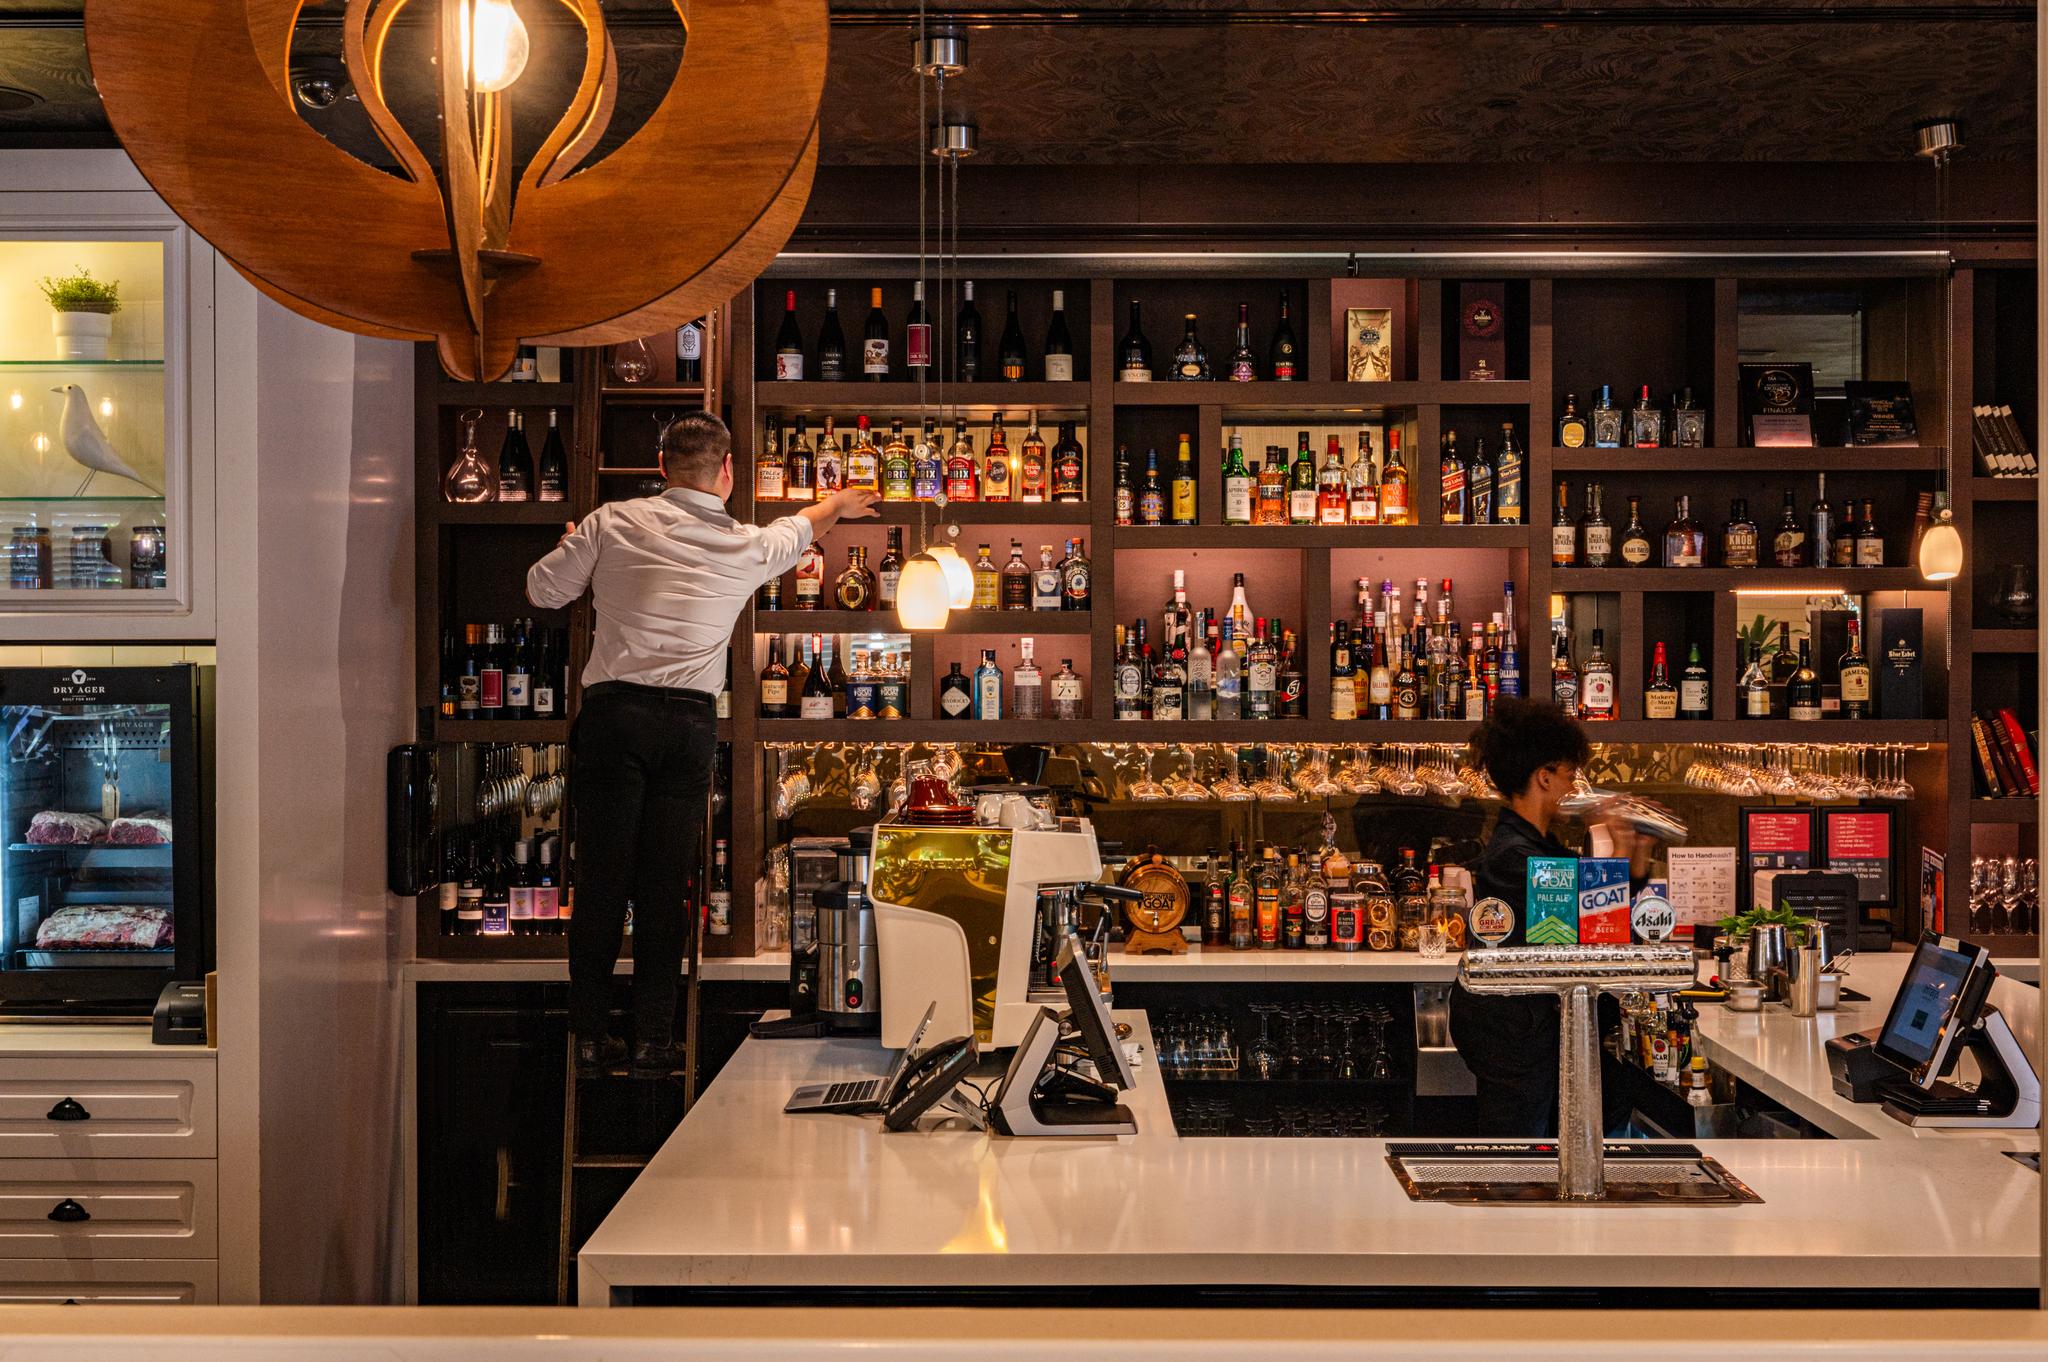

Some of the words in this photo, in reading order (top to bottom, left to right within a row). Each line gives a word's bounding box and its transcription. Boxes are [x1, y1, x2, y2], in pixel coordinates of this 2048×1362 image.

[887, 470, 908, 480] BRIX
[916, 470, 936, 480] BRIX
[949, 470, 969, 480] BRIX
[1729, 535, 1752, 545] KNOB
[1499, 669, 1519, 679] GALLIANO
[1844, 670, 1869, 678] JAMESON
[53, 686, 74, 694] DRY
[77, 686, 106, 694] AGER
[1402, 694, 1413, 703] 43
[1540, 877, 1573, 888] GOAT
[1537, 893, 1553, 902] PALE
[1555, 893, 1569, 902] ALE
[1581, 887, 1627, 910] GOAT
[1143, 899, 1175, 910] GOAT
[1635, 912, 1672, 927] Asahi
[1595, 926, 1614, 934] BEER
